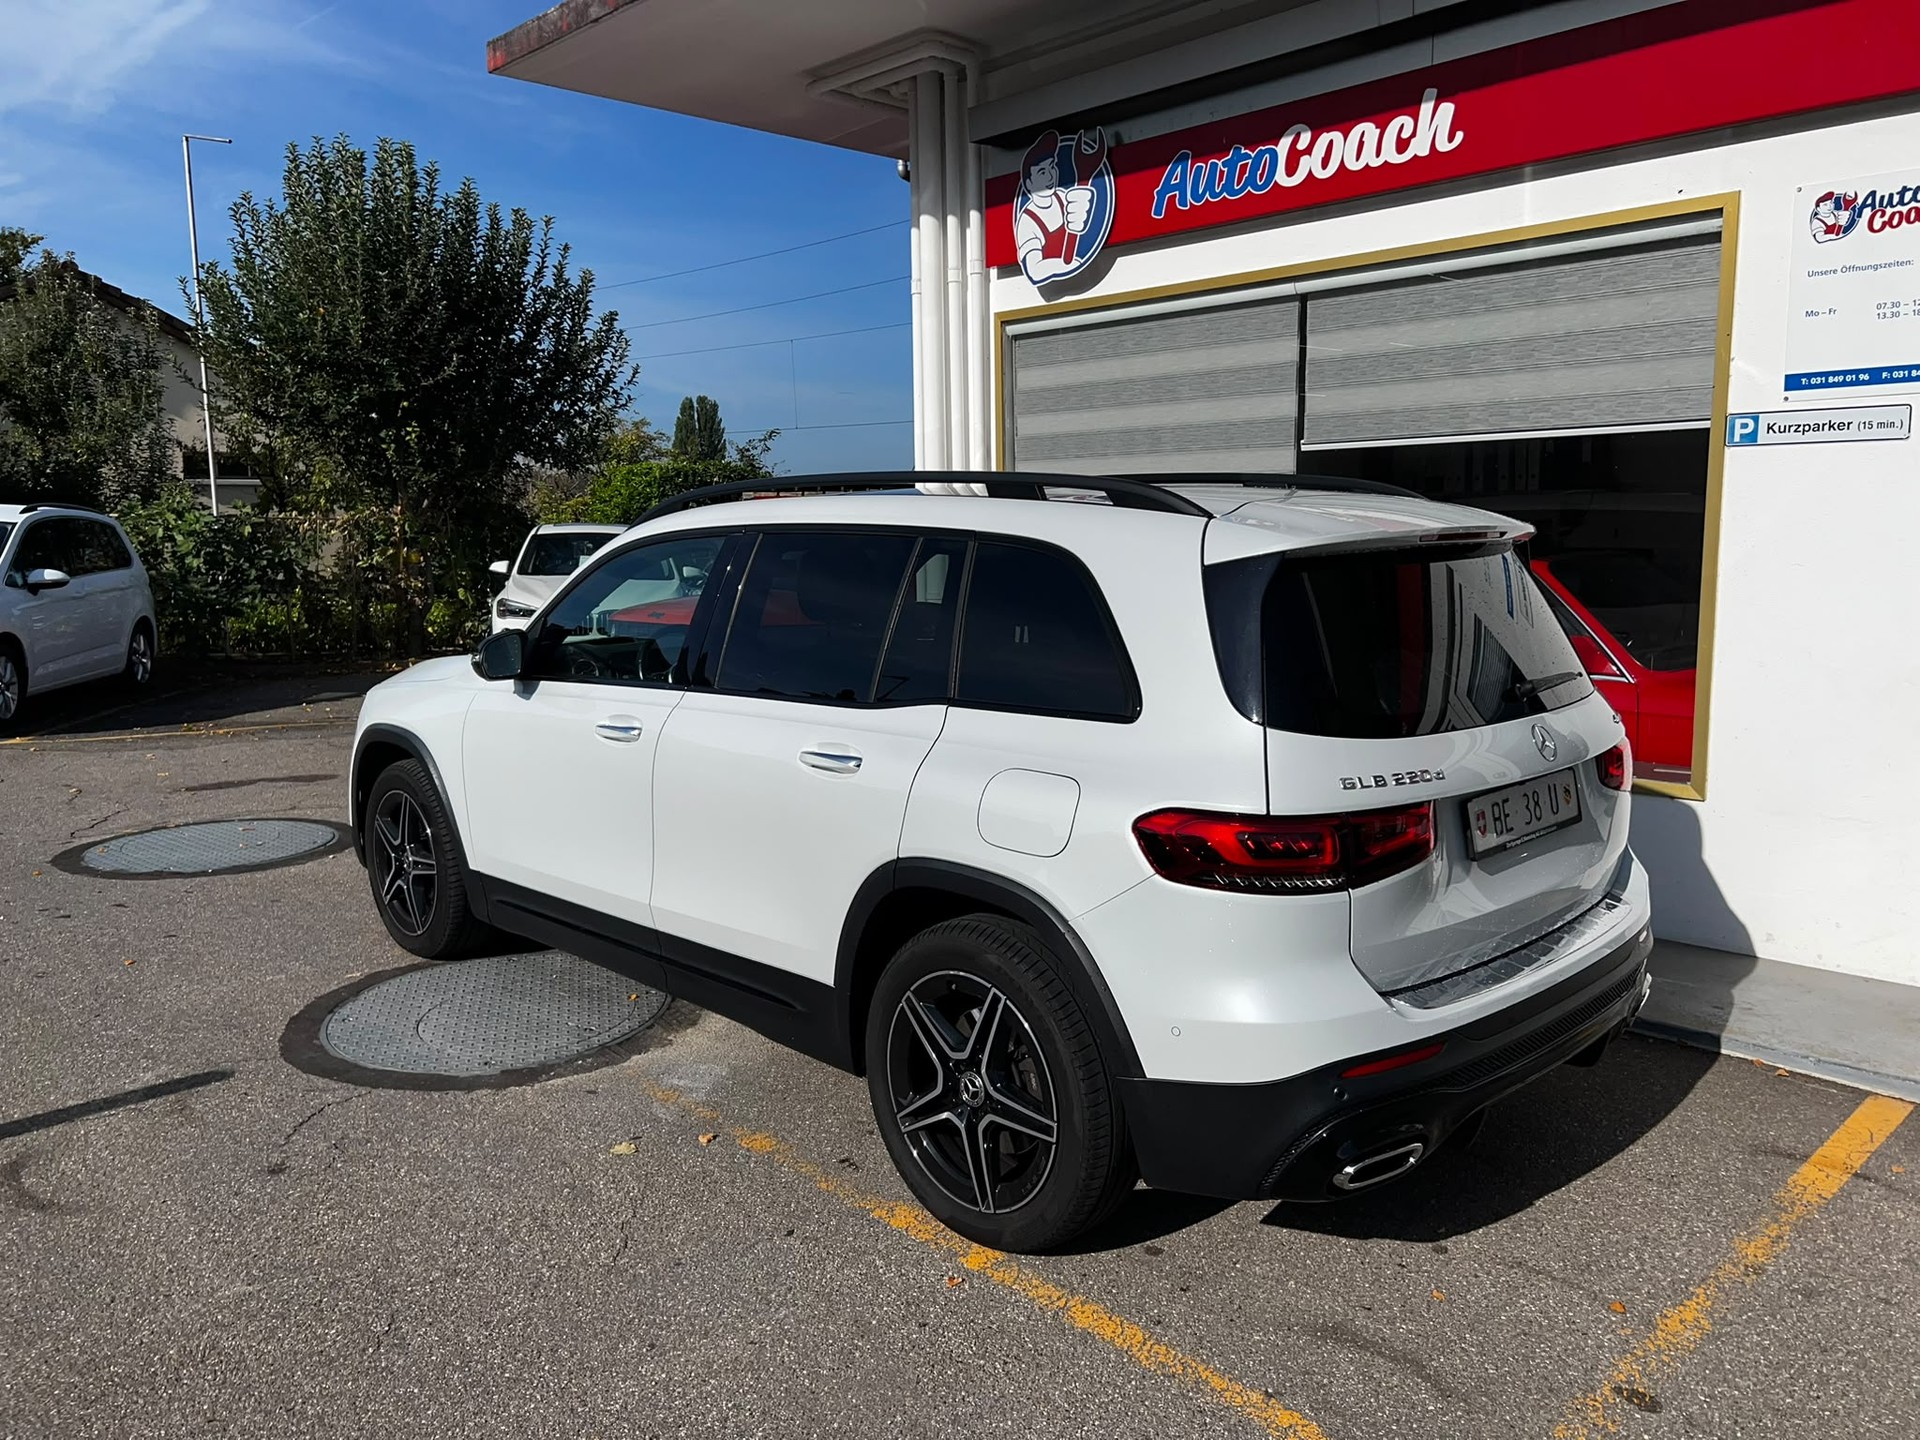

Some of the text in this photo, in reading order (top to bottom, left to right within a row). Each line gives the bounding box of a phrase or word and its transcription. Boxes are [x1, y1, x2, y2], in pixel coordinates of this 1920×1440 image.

[1151, 88, 1463, 219] AutoCoach
[1807, 259, 1914, 278] Unsere Öffnungszeiten:
[1805, 310, 1820, 318] Mo
[1828, 308, 1837, 316] Fr
[1876, 301, 1901, 311] 07.30
[1877, 310, 1901, 320] 13.30
[1810, 376, 1826, 385] 031
[1828, 375, 1844, 384] 849
[1845, 374, 1856, 382] 01
[1858, 373, 1870, 381] 96
[1882, 371, 1891, 379] F:
[1892, 370, 1908, 378] 031
[1733, 418, 1755, 443] P
[1766, 418, 1904, 436] Kurzparker (15 min.)
[1339, 774, 1388, 790] GLB
[1492, 783, 1560, 836] BE 38 U
